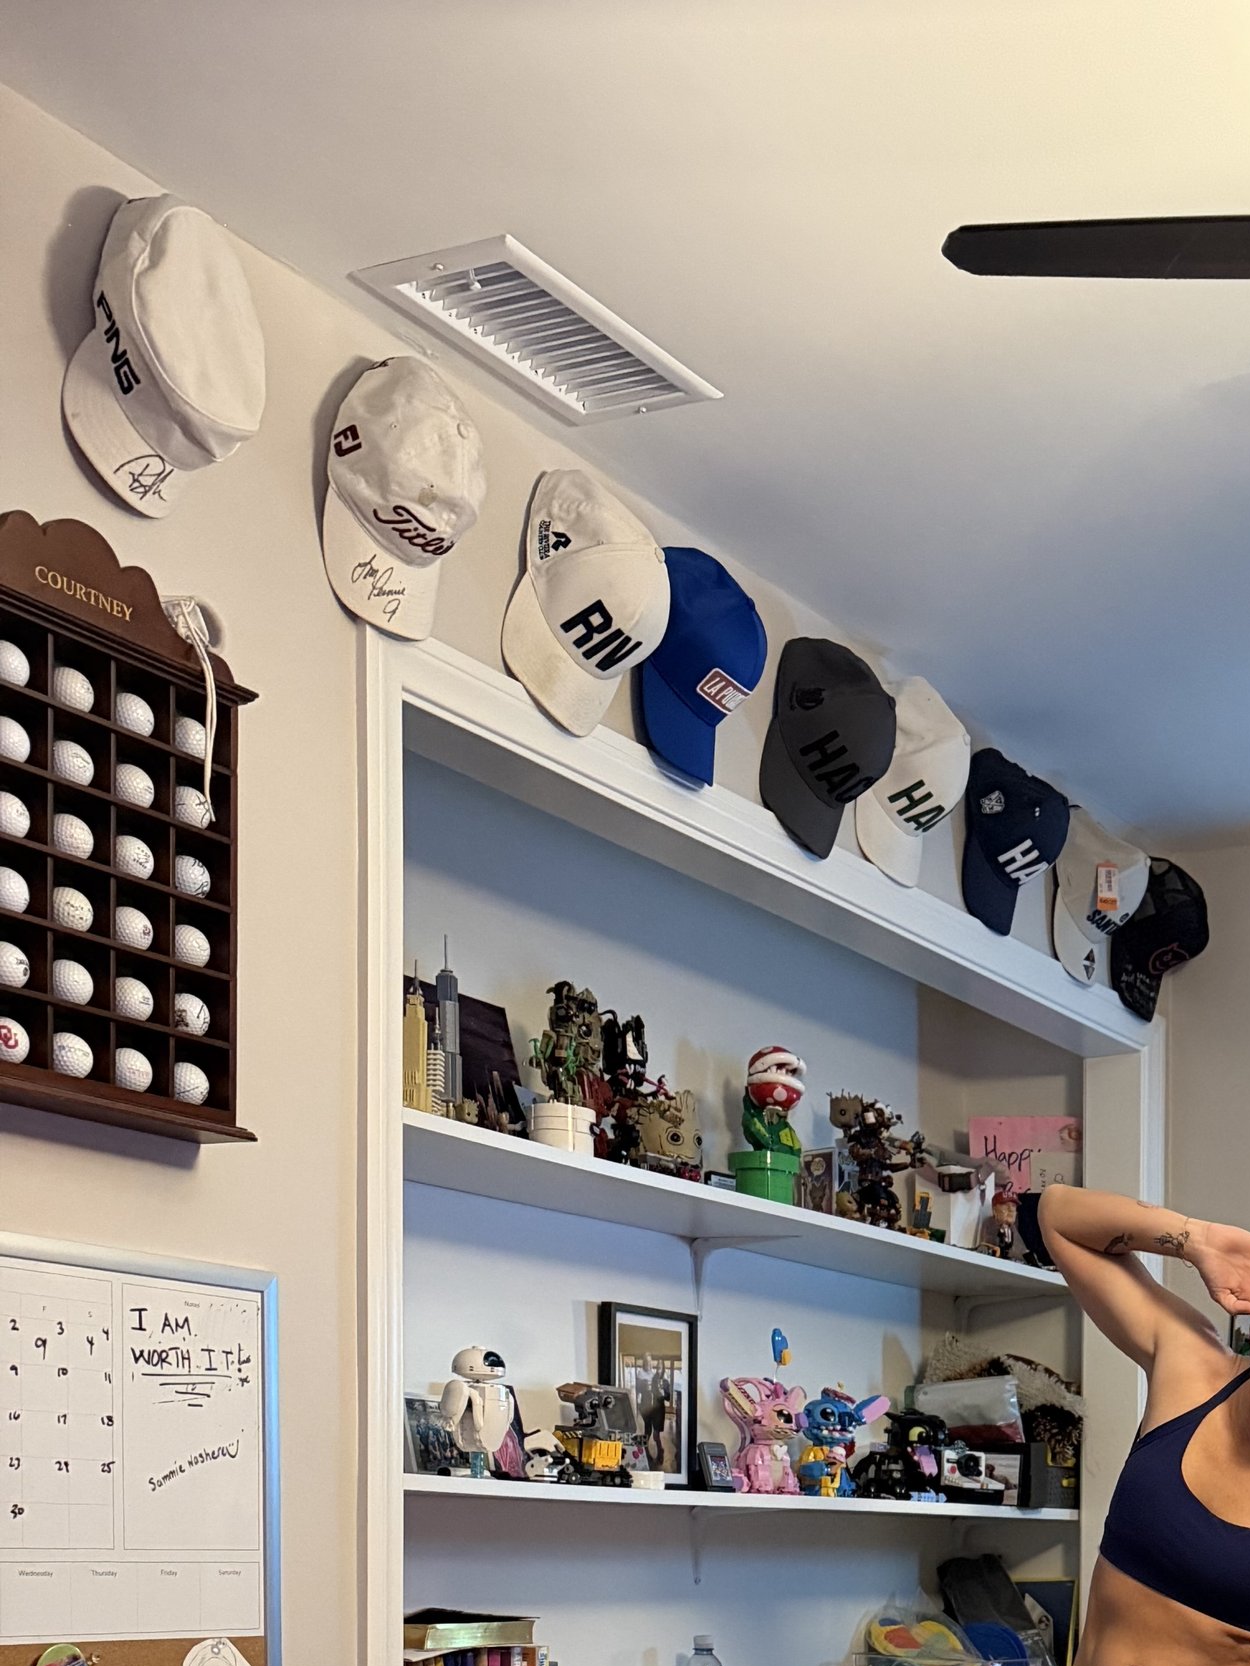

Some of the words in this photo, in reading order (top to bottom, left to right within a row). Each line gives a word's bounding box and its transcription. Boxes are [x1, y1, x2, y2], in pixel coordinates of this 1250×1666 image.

[97, 290, 141, 395] PING
[333, 424, 362, 457] FJ
[35, 566, 133, 622] COURTNEY
[560, 599, 643, 672] RIV
[703, 677, 721, 695] LA
[984, 1134, 1041, 1172] Happ
[9, 1318, 20, 1331] 2
[56, 1321, 65, 1336] 3
[102, 1327, 110, 1342] 4
[129, 1307, 148, 1332] I
[34, 1337, 48, 1361] 9
[86, 1335, 95, 1356] 4
[130, 1346, 192, 1373] WORTH
[9, 1364, 19, 1377] 9
[57, 1367, 69, 1378] 10
[104, 1371, 112, 1385] 11
[9, 1410, 21, 1421] 16
[57, 1413, 68, 1425] 17
[100, 1415, 114, 1427] 18
[9, 1457, 21, 1471] 23
[55, 1461, 70, 1473] 24
[100, 1460, 116, 1474] 25
[10, 1503, 25, 1520] 30
[18, 1569, 54, 1579] Wednesday
[90, 1569, 118, 1578] Thursday
[160, 1568, 178, 1578] Friday
[218, 1568, 242, 1577] Saturday
